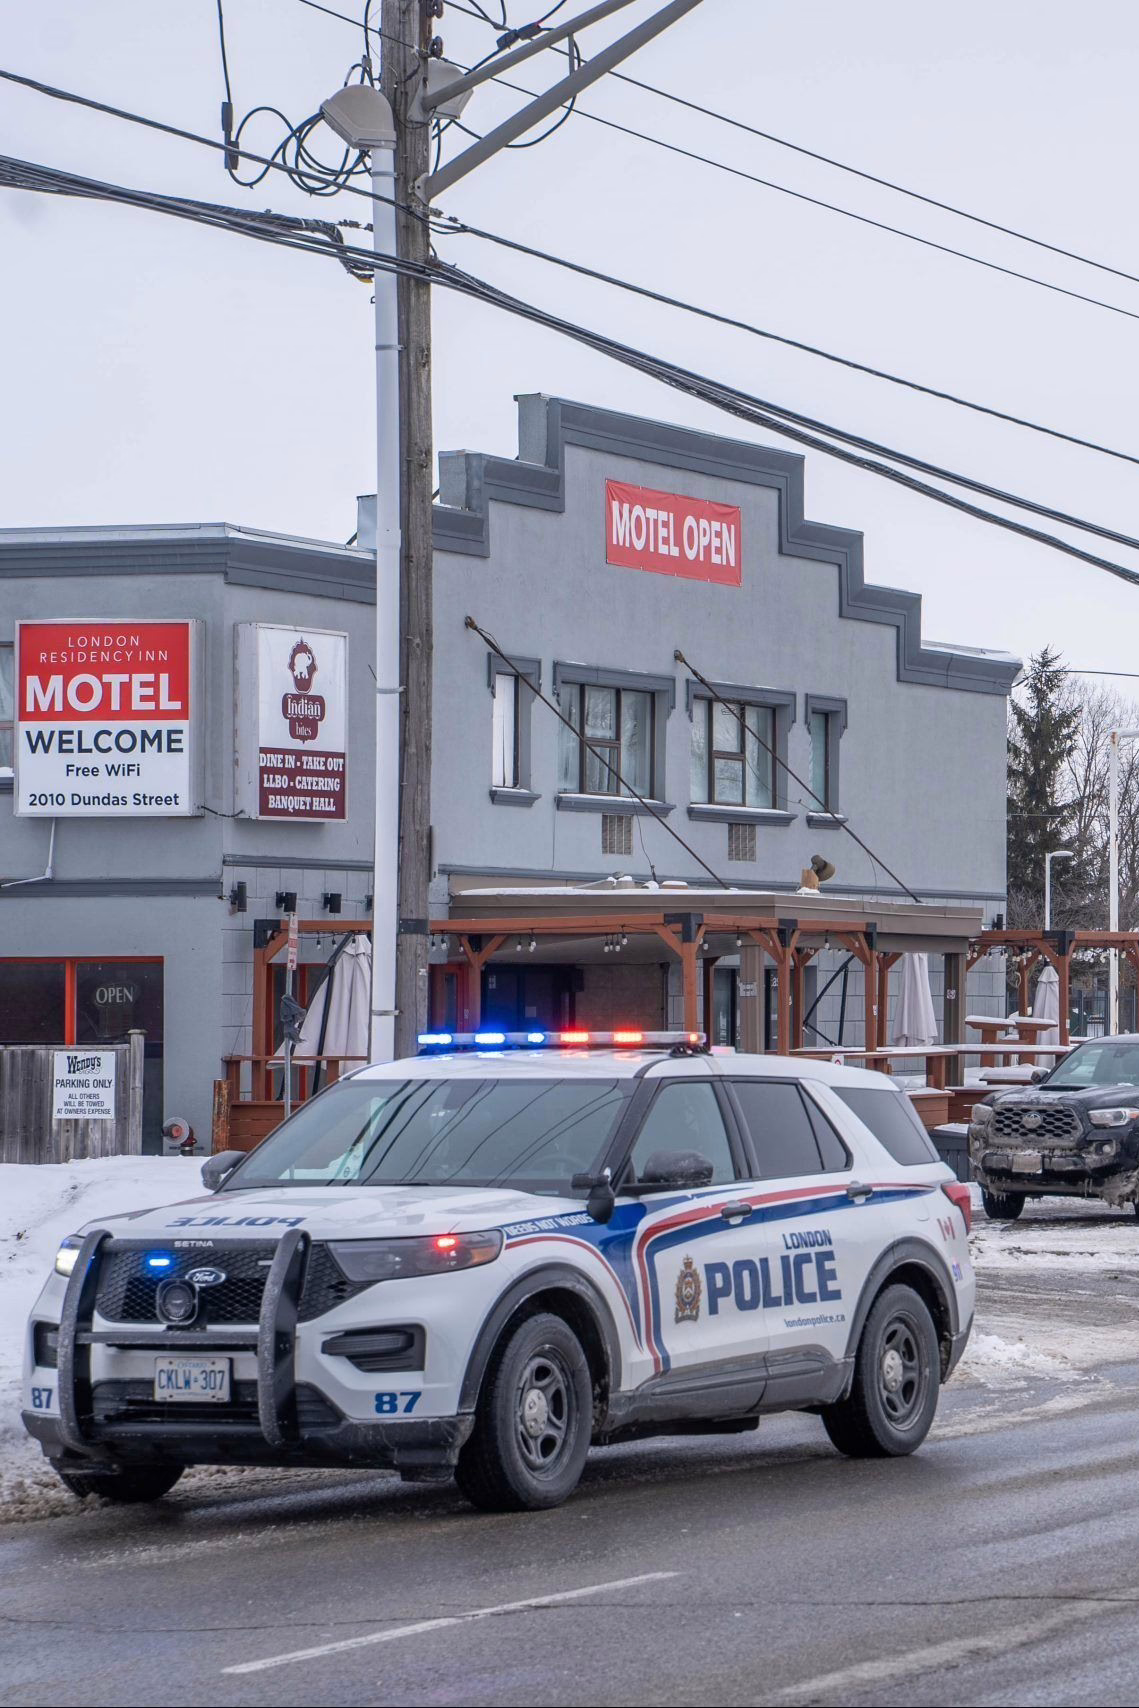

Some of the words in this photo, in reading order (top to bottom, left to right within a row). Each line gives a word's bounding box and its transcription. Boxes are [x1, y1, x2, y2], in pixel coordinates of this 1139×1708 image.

[612, 501, 680, 557] MOTEL
[683, 515, 735, 567] OPEN
[68, 636, 140, 648] LONDON
[40, 650, 132, 662] RESIDENCY
[139, 650, 168, 661] INN
[26, 673, 182, 712] MOTEL
[287, 696, 320, 719] Indian
[296, 721, 312, 736] bites
[25, 729, 184, 754] WELCOME
[66, 764, 100, 777] Free
[105, 764, 140, 777] WiFi
[260, 753, 284, 767] DINE
[285, 754, 296, 768] IN
[302, 756, 326, 770] TAKE
[327, 758, 344, 772] OUT
[263, 774, 288, 788] LLBO
[295, 776, 340, 792] CATERING
[29, 793, 66, 806] 2010
[71, 792, 128, 806] Dundas
[132, 793, 180, 806] Street
[268, 795, 312, 812] BANQUET
[312, 798, 336, 812] HALL
[96, 986, 134, 1004] OPEN
[56, 1078, 90, 1088] PARKING
[92, 1078, 112, 1088] ONLY
[534, 1218, 559, 1232] NOT
[555, 1213, 595, 1228] WORDS
[782, 1230, 832, 1250] LONDON
[192, 1272, 216, 1282] Ford
[704, 1250, 842, 1316] POLICE
[32, 1387, 52, 1408] 87
[374, 1391, 422, 1414] 87
